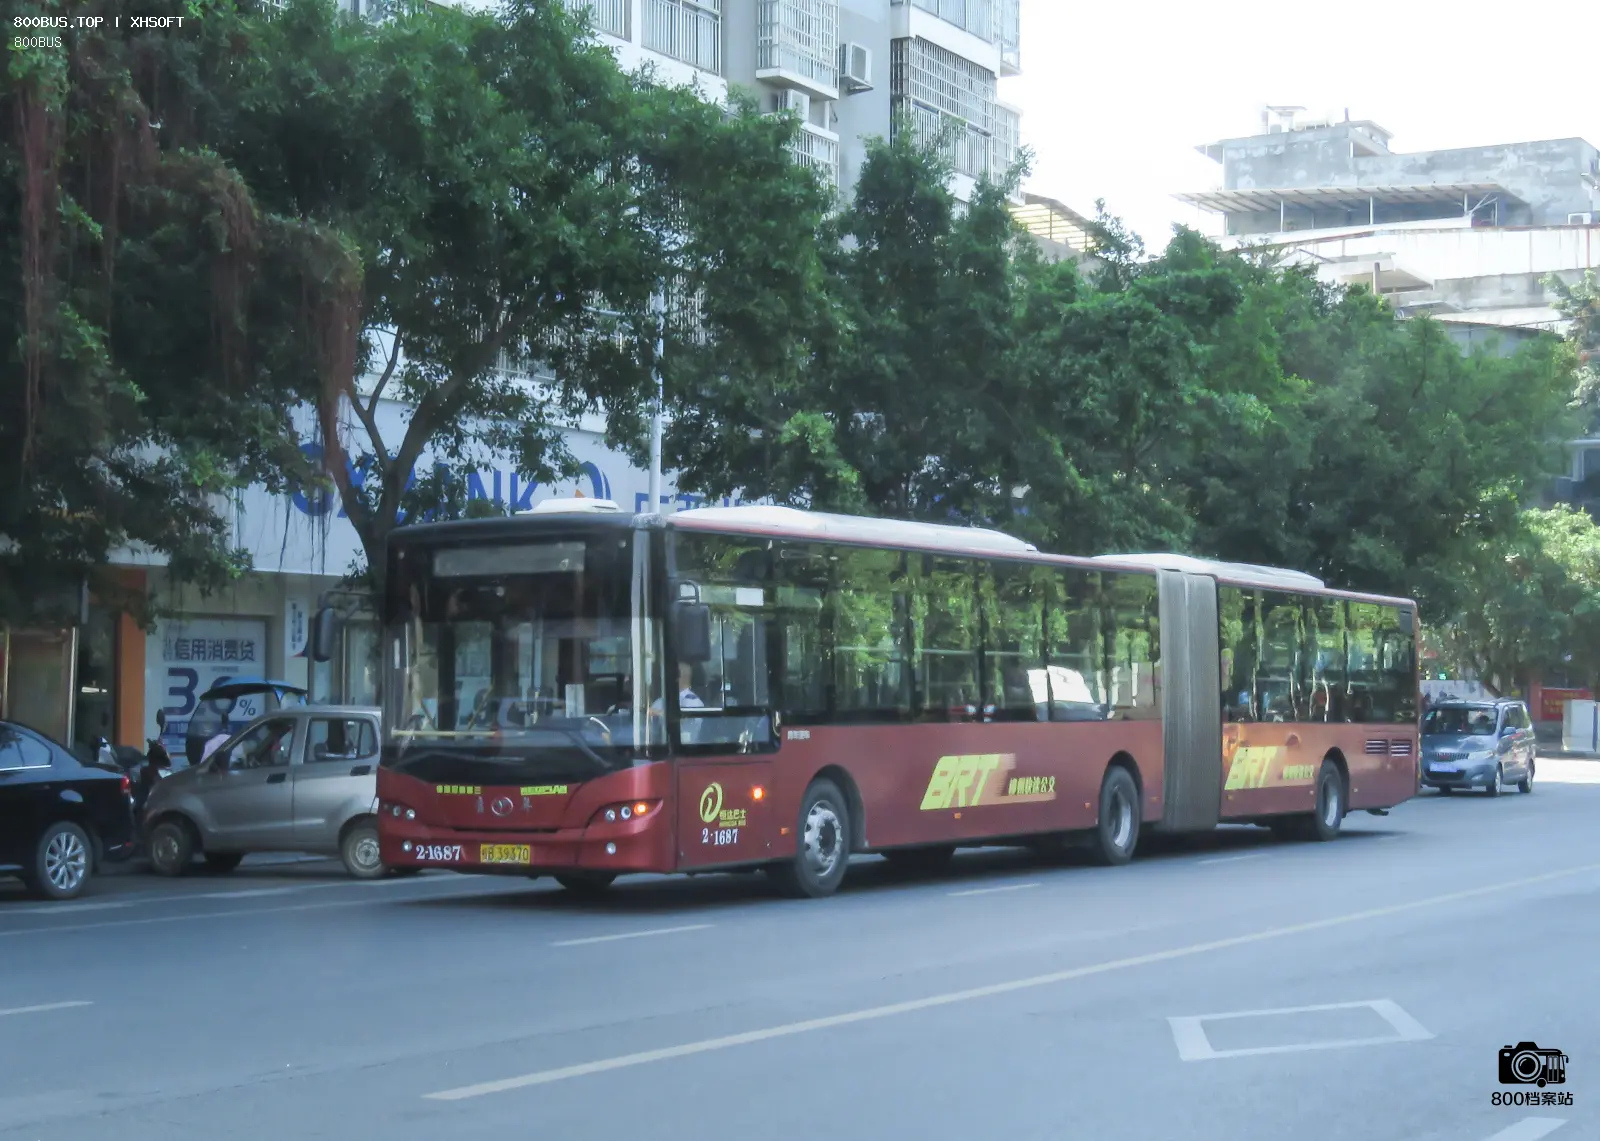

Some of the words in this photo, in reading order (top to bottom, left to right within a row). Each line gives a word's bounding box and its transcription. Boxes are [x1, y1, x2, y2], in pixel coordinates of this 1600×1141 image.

[175, 638, 255, 661] 信用消费贷
[920, 753, 1001, 810] BRT
